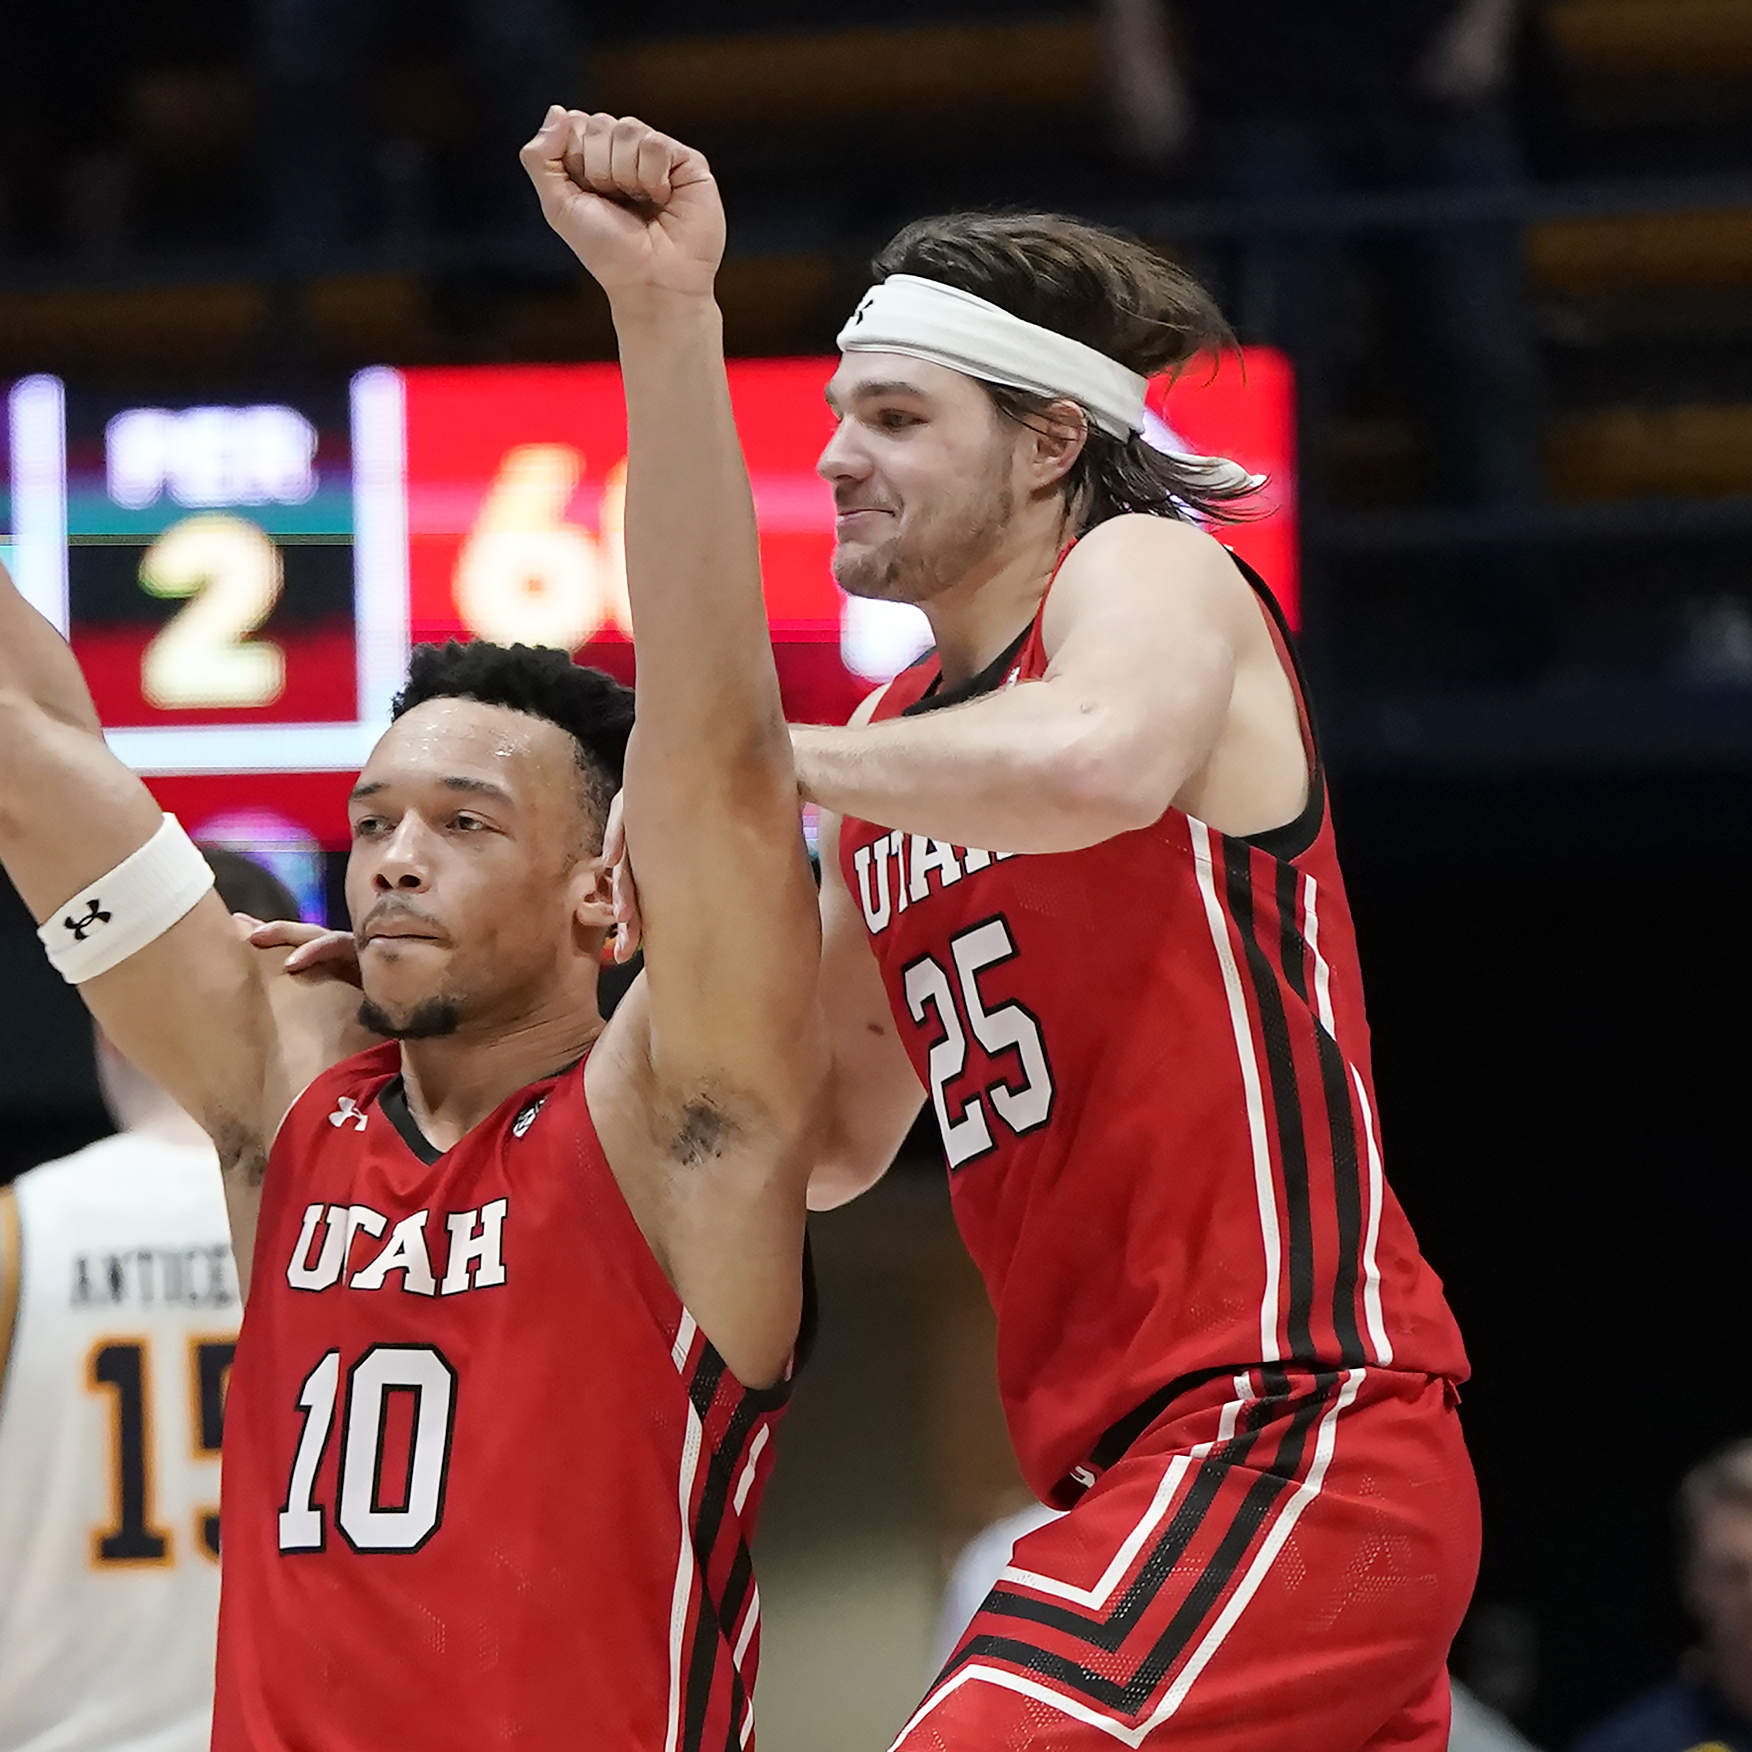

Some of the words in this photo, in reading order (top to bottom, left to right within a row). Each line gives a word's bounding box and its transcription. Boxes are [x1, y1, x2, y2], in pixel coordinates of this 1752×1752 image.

[139, 512, 286, 708] 2
[902, 912, 1056, 1172] 25
[277, 1342, 457, 1555] 10
